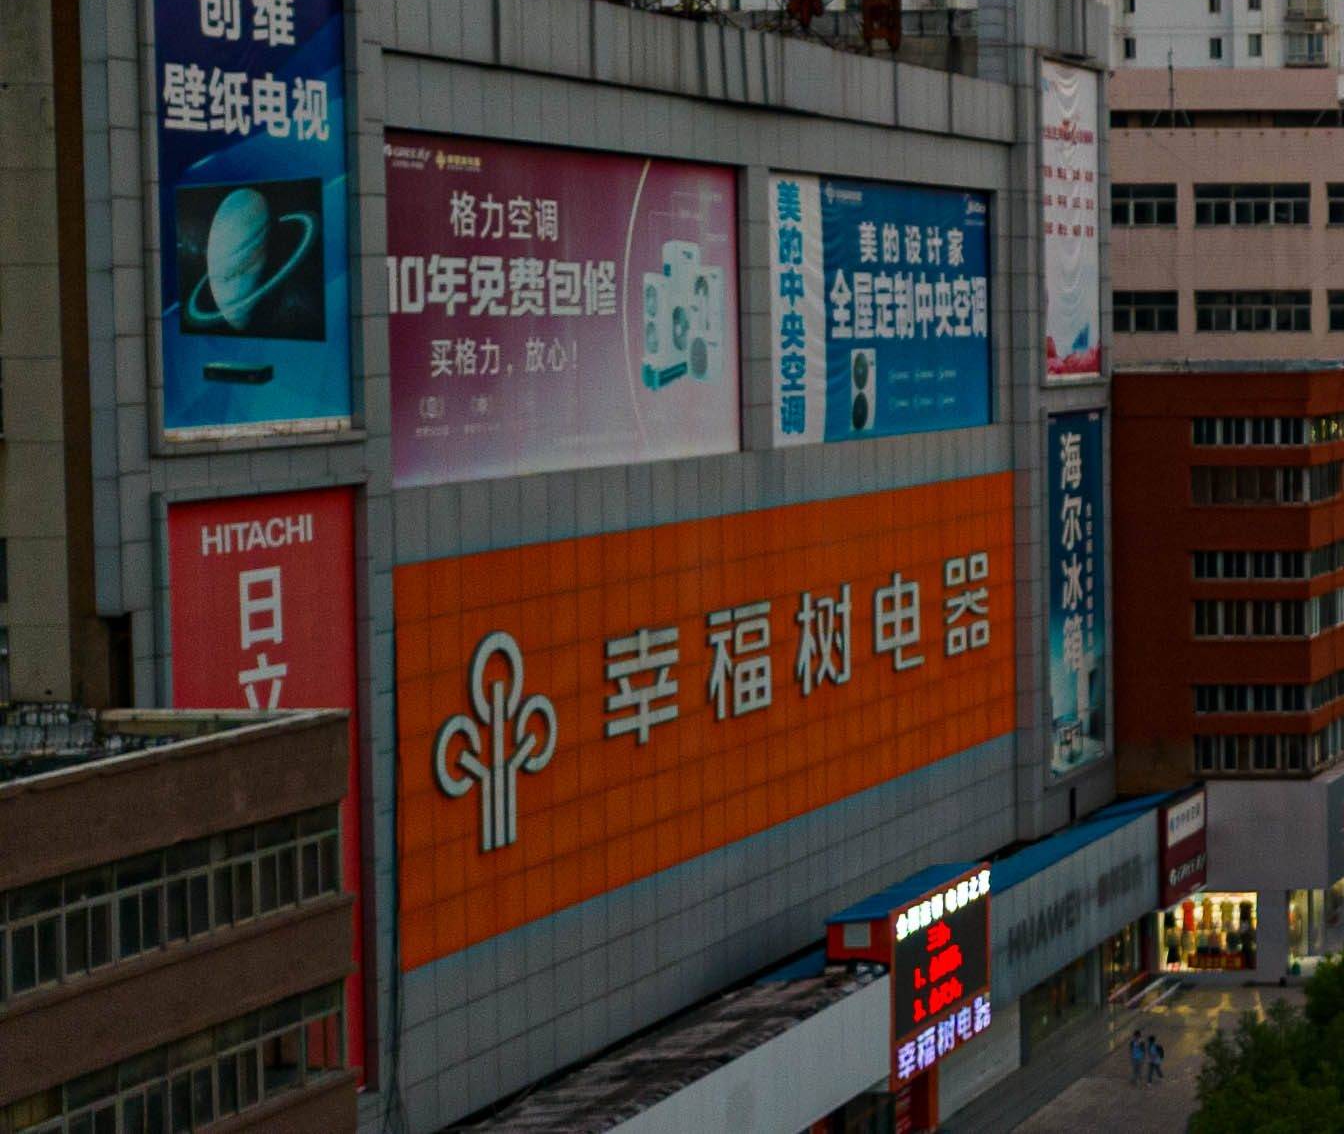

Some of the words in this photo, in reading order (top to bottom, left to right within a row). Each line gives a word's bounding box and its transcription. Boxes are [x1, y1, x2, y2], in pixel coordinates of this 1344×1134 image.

[162, 63, 330, 141] 壁纸电视
[449, 190, 559, 243] 格力空调
[858, 221, 965, 267] 美的设计家
[386, 254, 617, 316] 10年免费包修
[776, 179, 807, 435] 美的中央空调
[829, 268, 988, 341] 全屋定制中央空调
[201, 513, 313, 556] HITACHI
[1059, 432, 1084, 672] 海尔冰箱
[238, 566, 288, 710] 日立
[606, 551, 992, 745] 幸福树电器
[897, 996, 991, 1079] 幸福树电器
